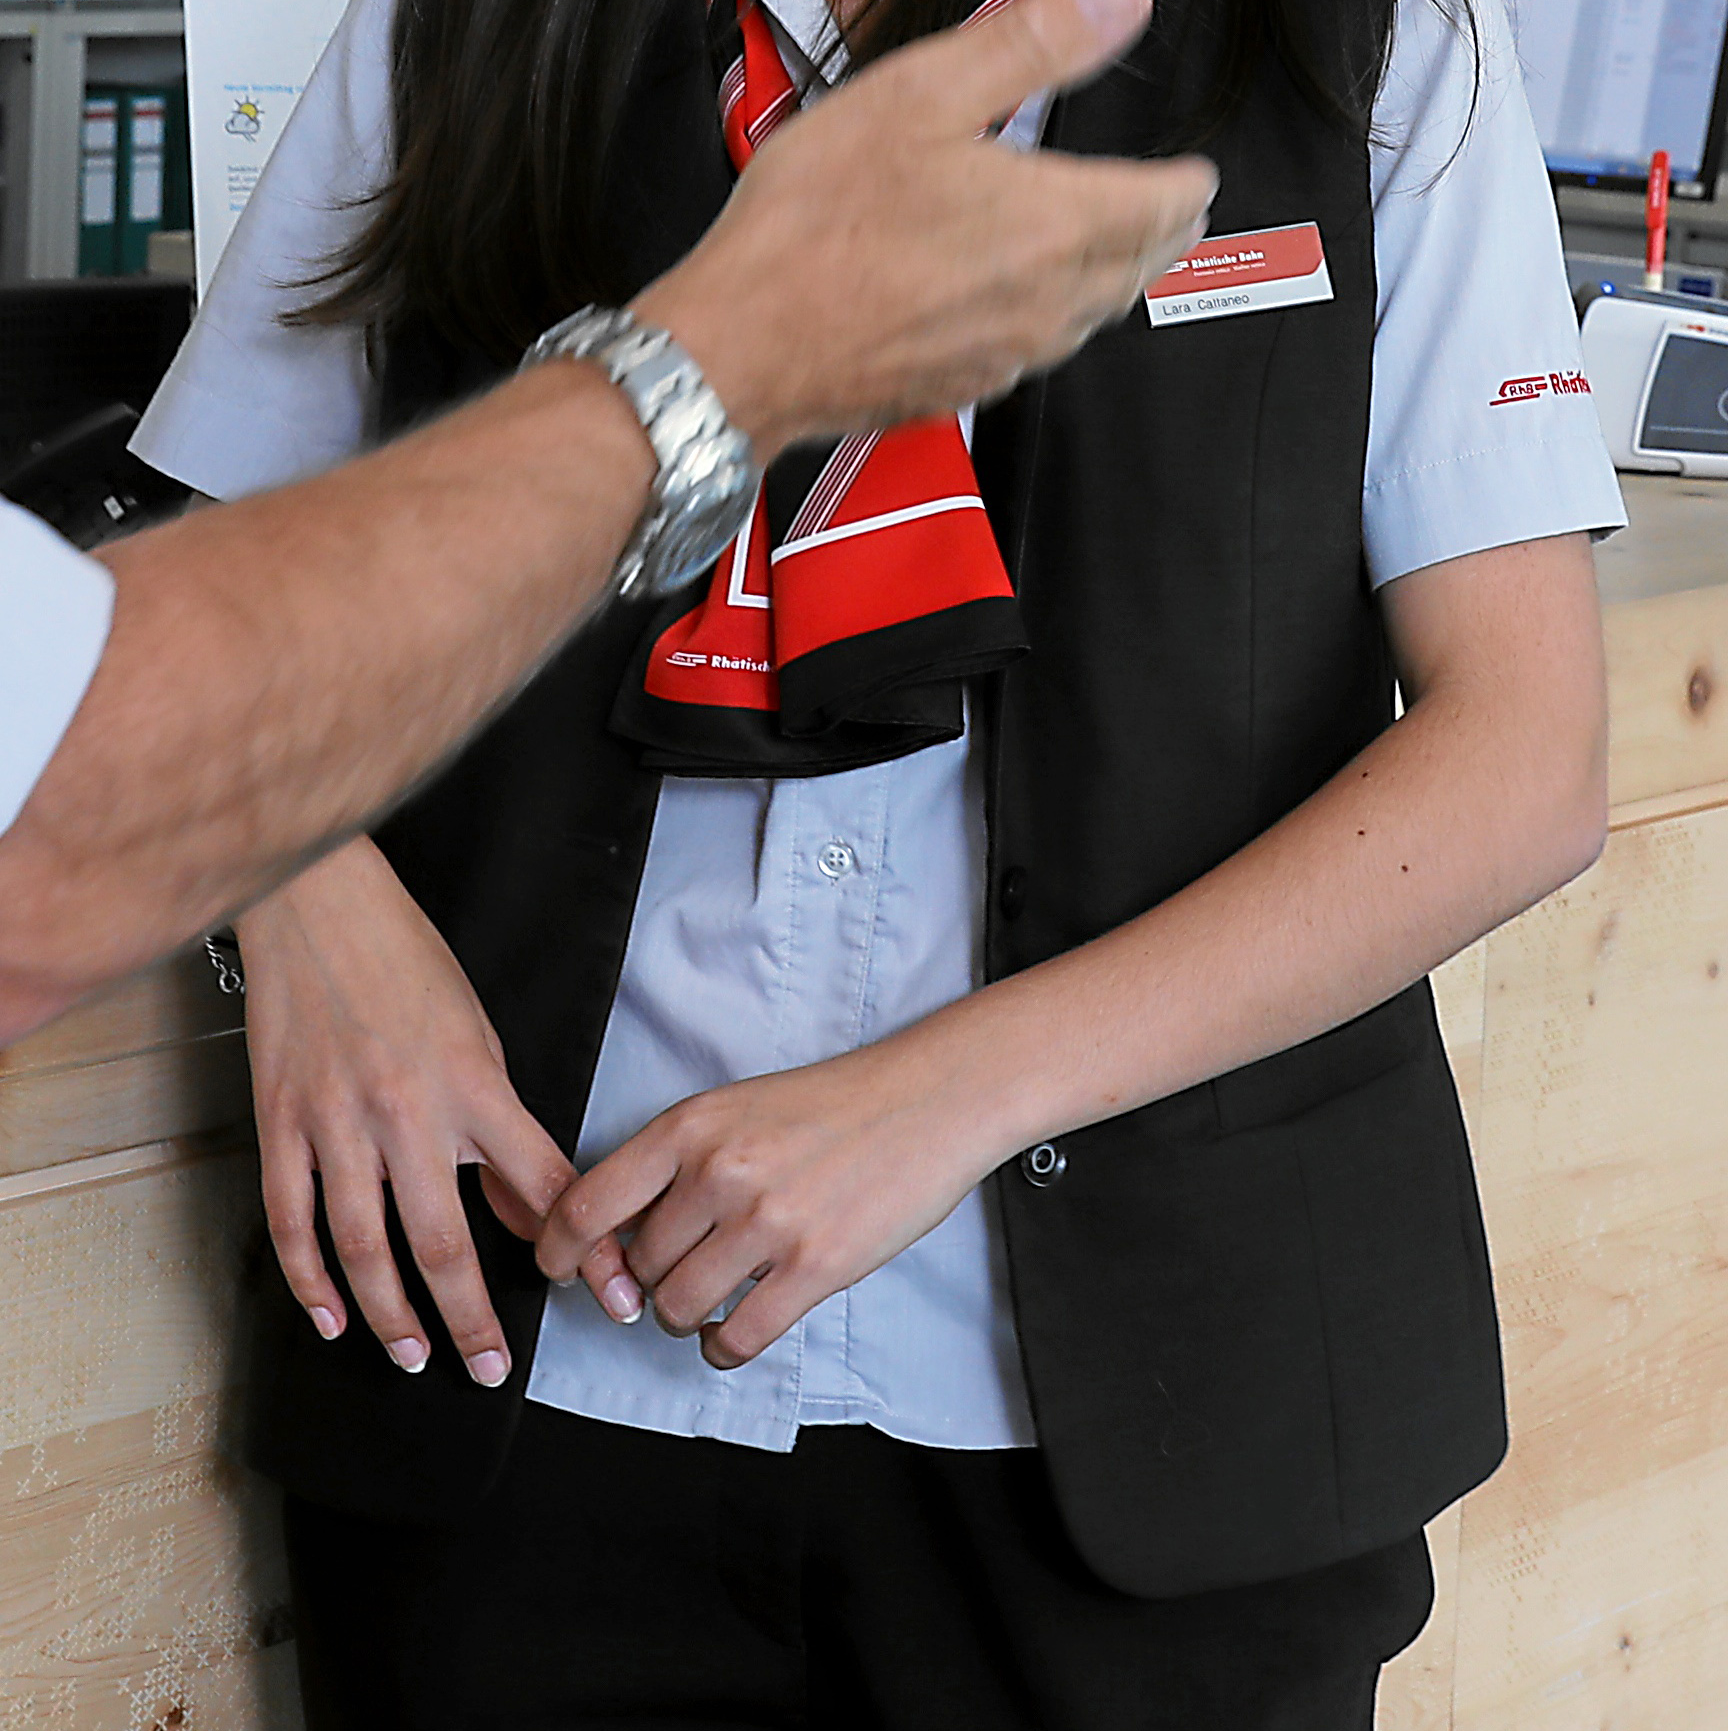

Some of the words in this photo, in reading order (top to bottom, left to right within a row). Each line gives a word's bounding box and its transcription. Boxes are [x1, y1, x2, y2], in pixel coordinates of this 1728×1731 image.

[1191, 255, 1237, 269] Rhätische
[1239, 250, 1264, 262] Bahn
[1163, 304, 1191, 316] Lara
